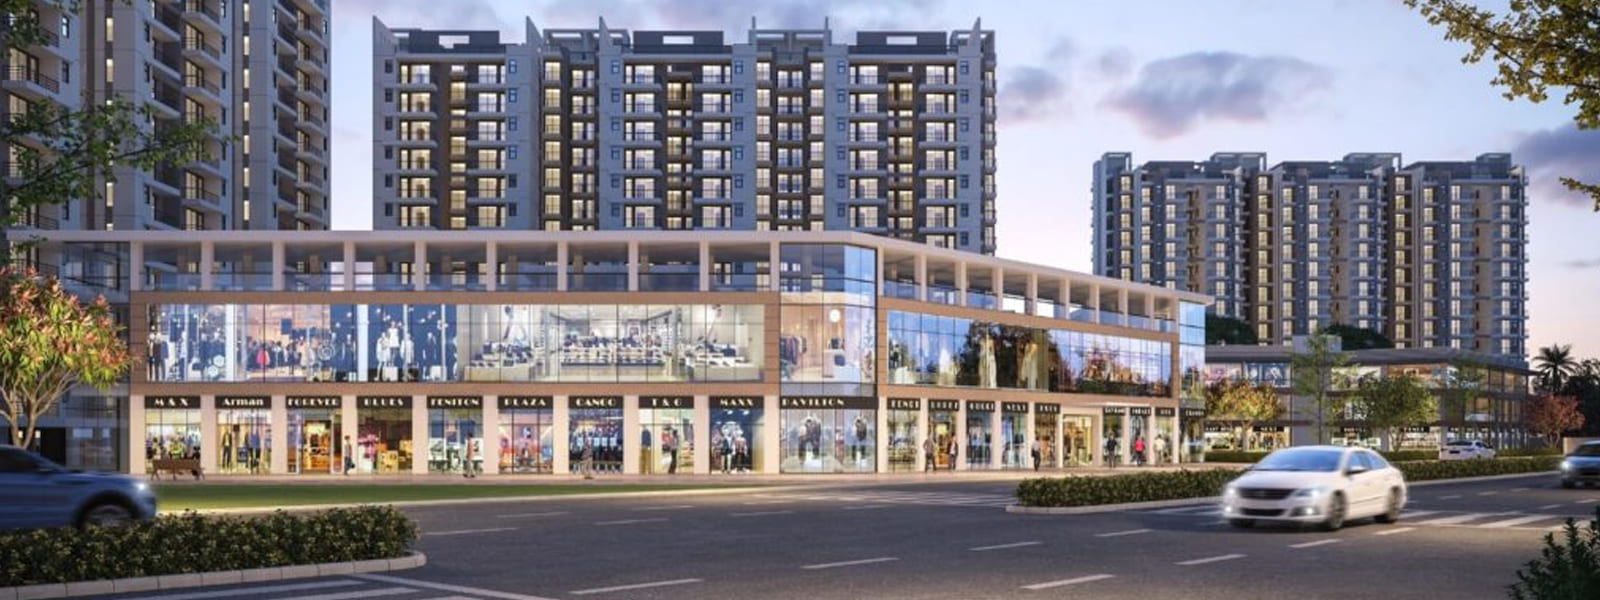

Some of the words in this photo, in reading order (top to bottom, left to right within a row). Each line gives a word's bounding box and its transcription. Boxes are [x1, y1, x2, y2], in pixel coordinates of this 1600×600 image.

[222, 398, 264, 406] Arman
[287, 398, 340, 406] FOREVER
[363, 398, 404, 406] BLUES
[504, 398, 546, 406] PLAZA
[719, 398, 754, 406] MAXX
[781, 398, 845, 406] PAVILION
